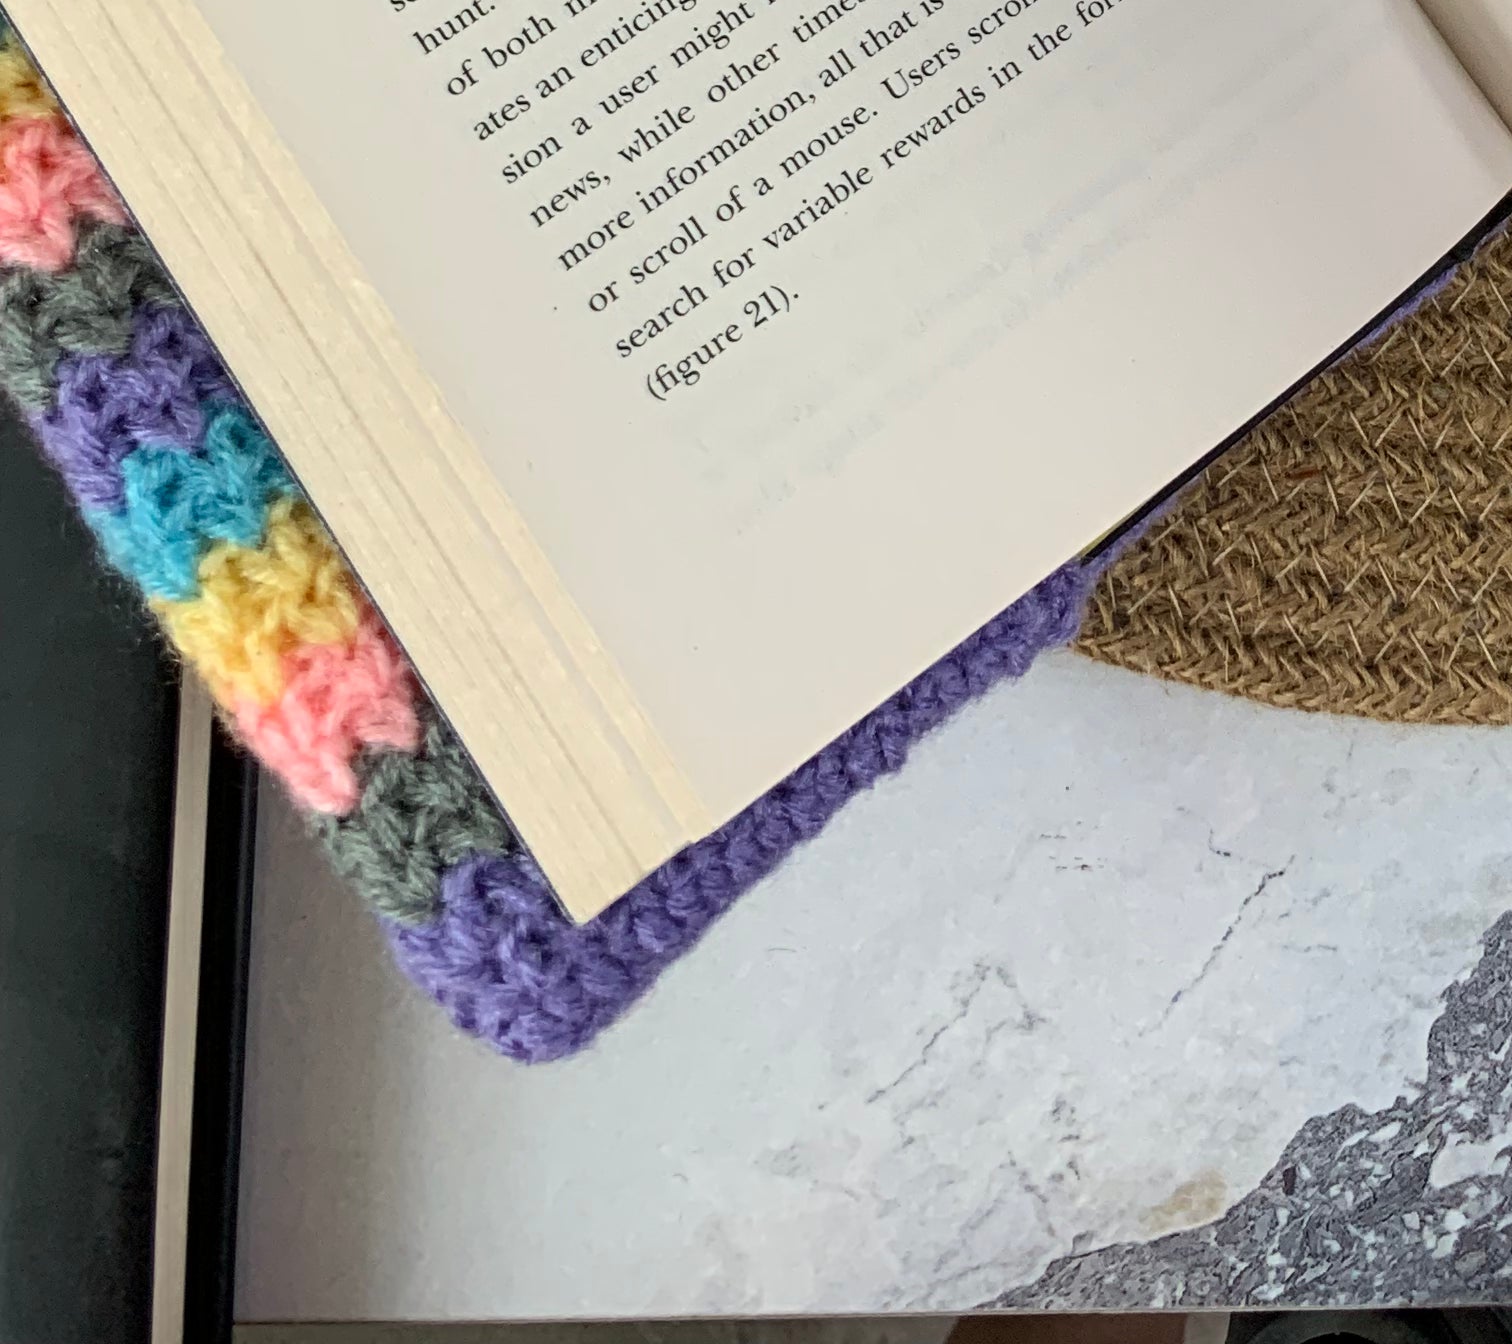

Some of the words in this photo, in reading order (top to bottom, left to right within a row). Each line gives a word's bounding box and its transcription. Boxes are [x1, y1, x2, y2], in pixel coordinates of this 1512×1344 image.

[616, 285, 709, 358] search
[712, 247, 756, 288] for
[761, 167, 874, 249] variable
[879, 85, 986, 169] rewards
[987, 61, 1023, 89] in
[1027, 24, 1072, 61] the
[646, 324, 743, 401] (figure
[743, 285, 799, 328] 21).
